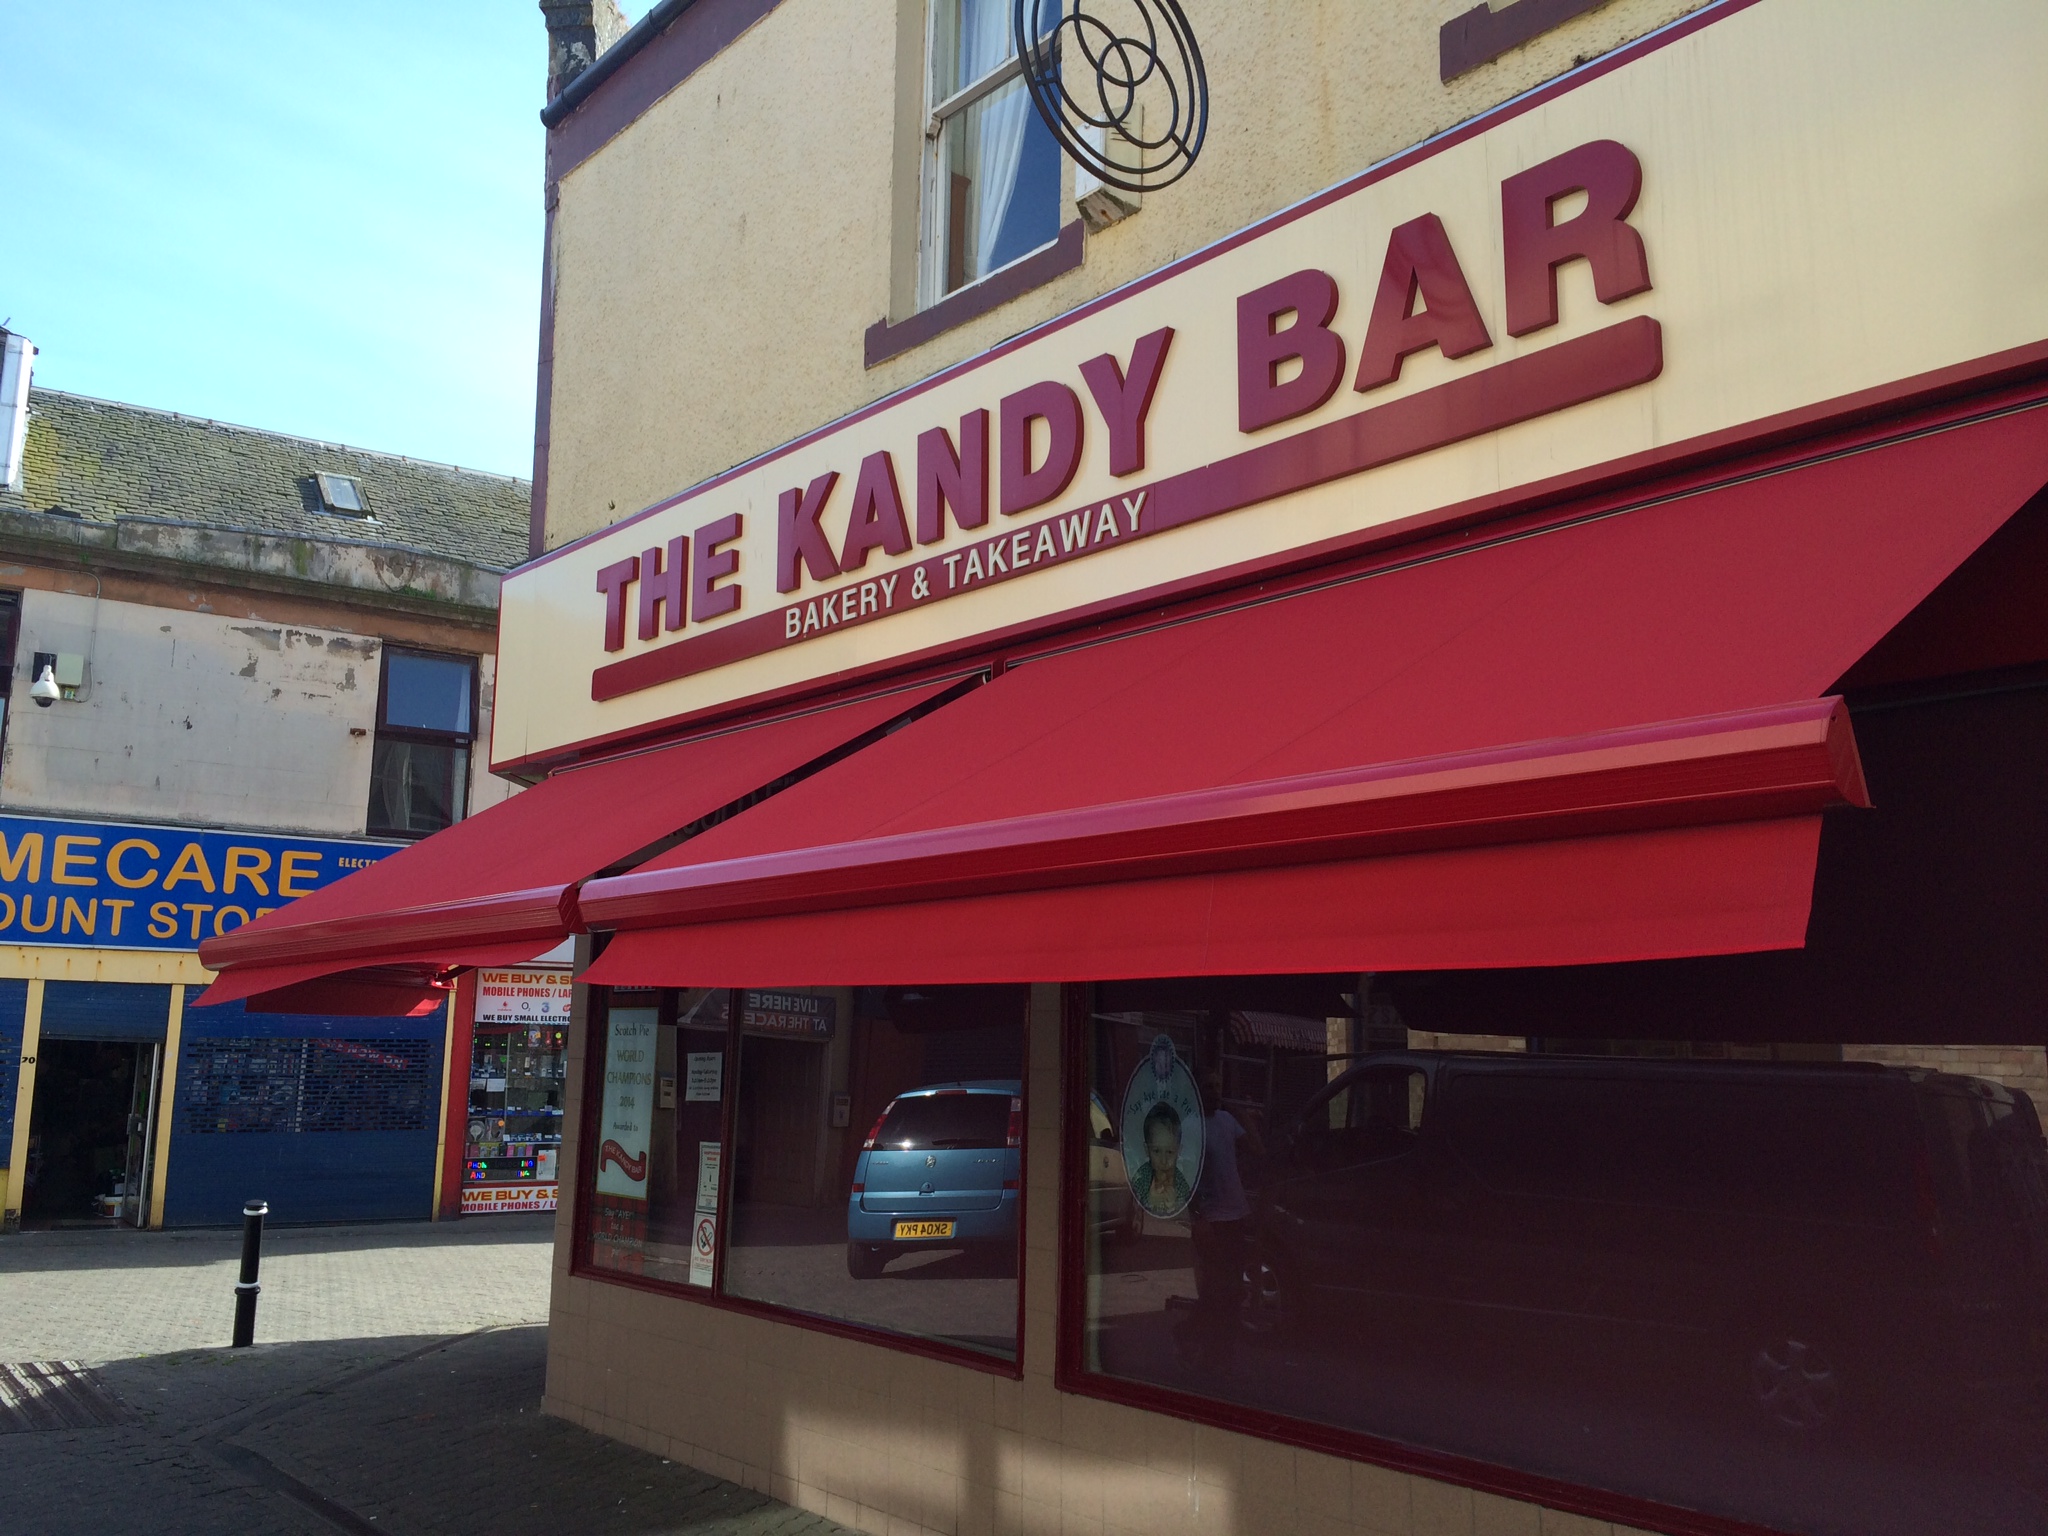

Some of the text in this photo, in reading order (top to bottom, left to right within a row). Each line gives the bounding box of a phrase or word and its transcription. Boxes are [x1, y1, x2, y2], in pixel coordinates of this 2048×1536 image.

[596, 138, 1654, 652] THE KANDY BAR
[784, 490, 1148, 639] BAKERY & TAKEAWAY
[0, 830, 323, 899] MECARE
[147, 901, 277, 940] STO
[482, 973, 573, 985] WE BUY & S
[482, 986, 515, 997] MOBILE
[517, 987, 550, 998] PHONES
[615, 1022, 650, 1036] Scotch Pie
[616, 1049, 645, 1063] WORLD
[606, 1071, 652, 1086] CHAMPIONS
[619, 1095, 635, 1109] 2014
[612, 1121, 639, 1132] Awarded to
[604, 1145, 642, 1174] THE KANDY BAR
[470, 1171, 486, 1180] AND
[462, 1190, 492, 1202] WE
[495, 1189, 535, 1201] BUY
[536, 1189, 549, 1199] &
[462, 1203, 499, 1212] MOBILE
[501, 1201, 541, 1210] PHONES
